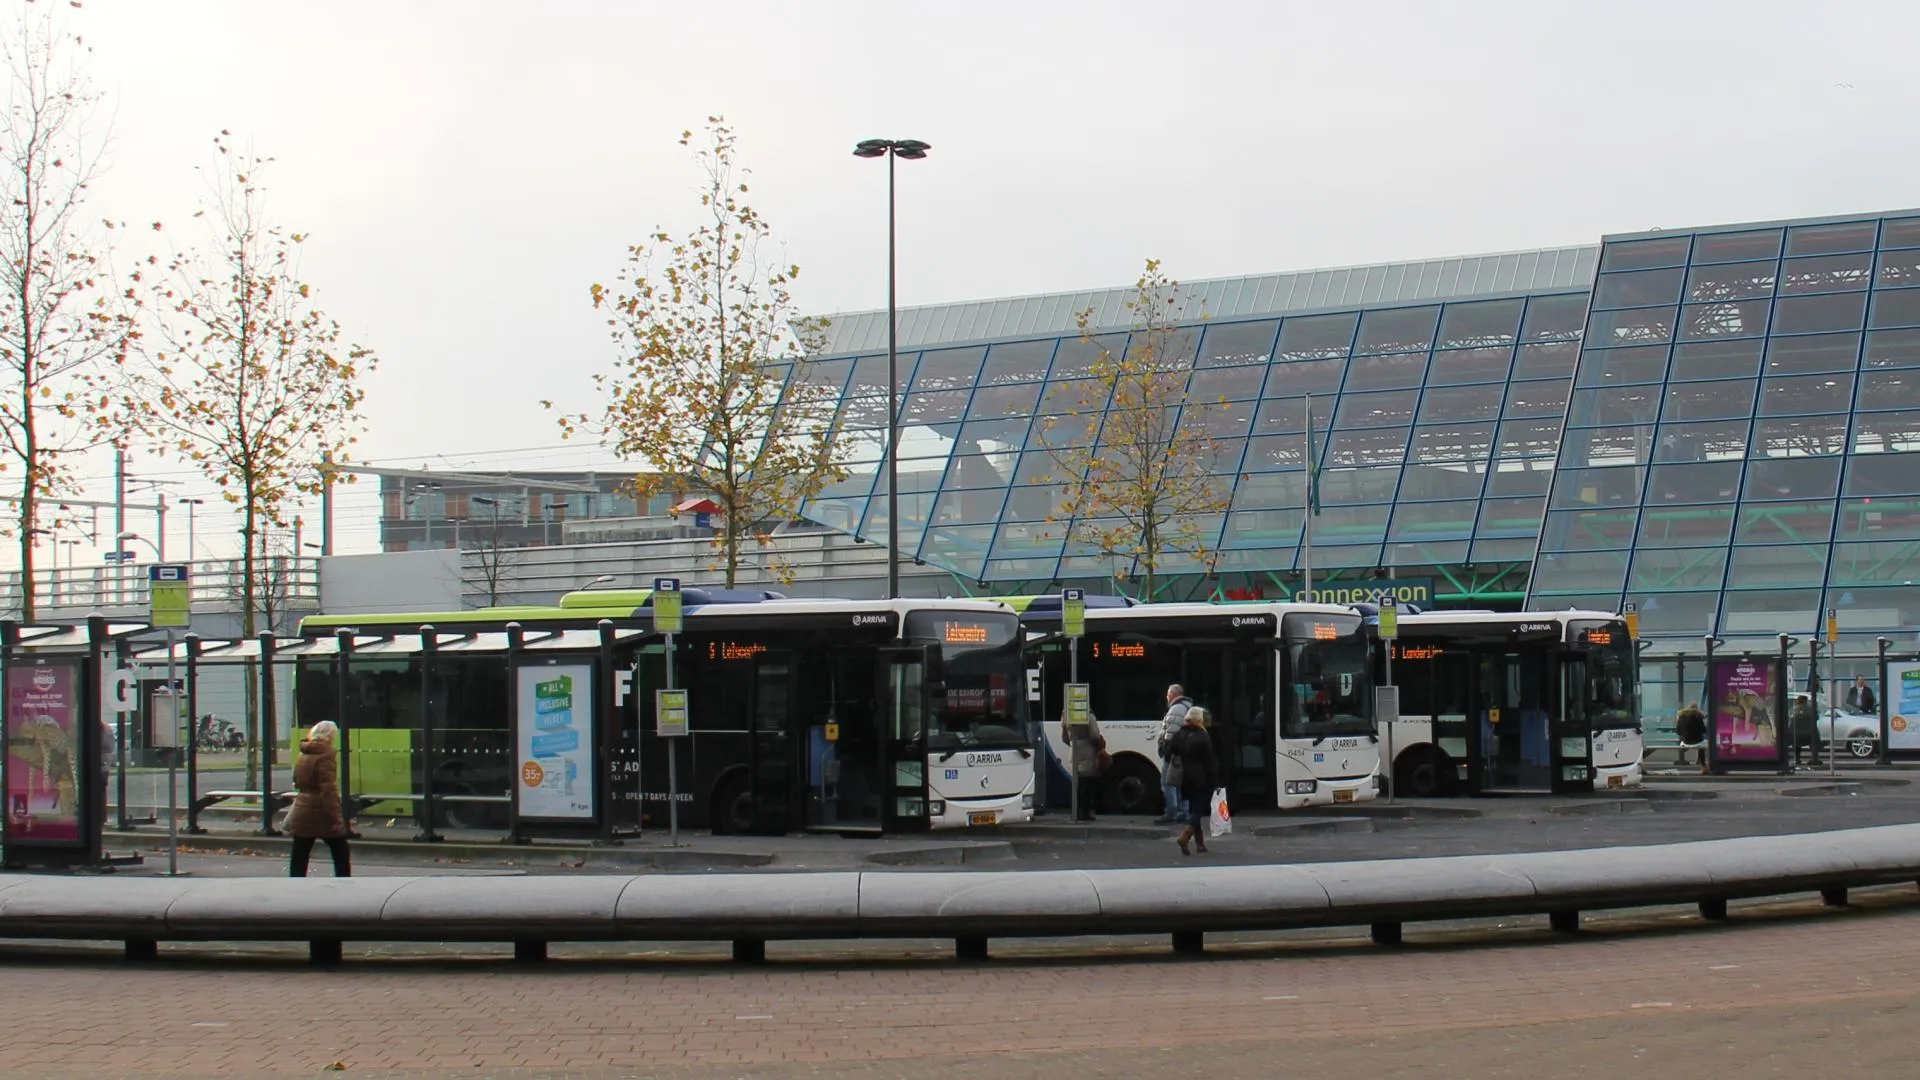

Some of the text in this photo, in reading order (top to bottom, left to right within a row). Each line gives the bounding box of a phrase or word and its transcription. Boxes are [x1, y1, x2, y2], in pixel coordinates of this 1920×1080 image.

[861, 615, 887, 624] ARRIVA
[1241, 617, 1266, 625] ARRIVA
[1111, 642, 1144, 657] Warande
[106, 669, 138, 711] G
[615, 670, 633, 707] F
[1026, 669, 1041, 701] E
[1339, 739, 1358, 748] ARRIVA
[976, 753, 1002, 764] ARRIVA
[650, 792, 667, 801] DAYS
